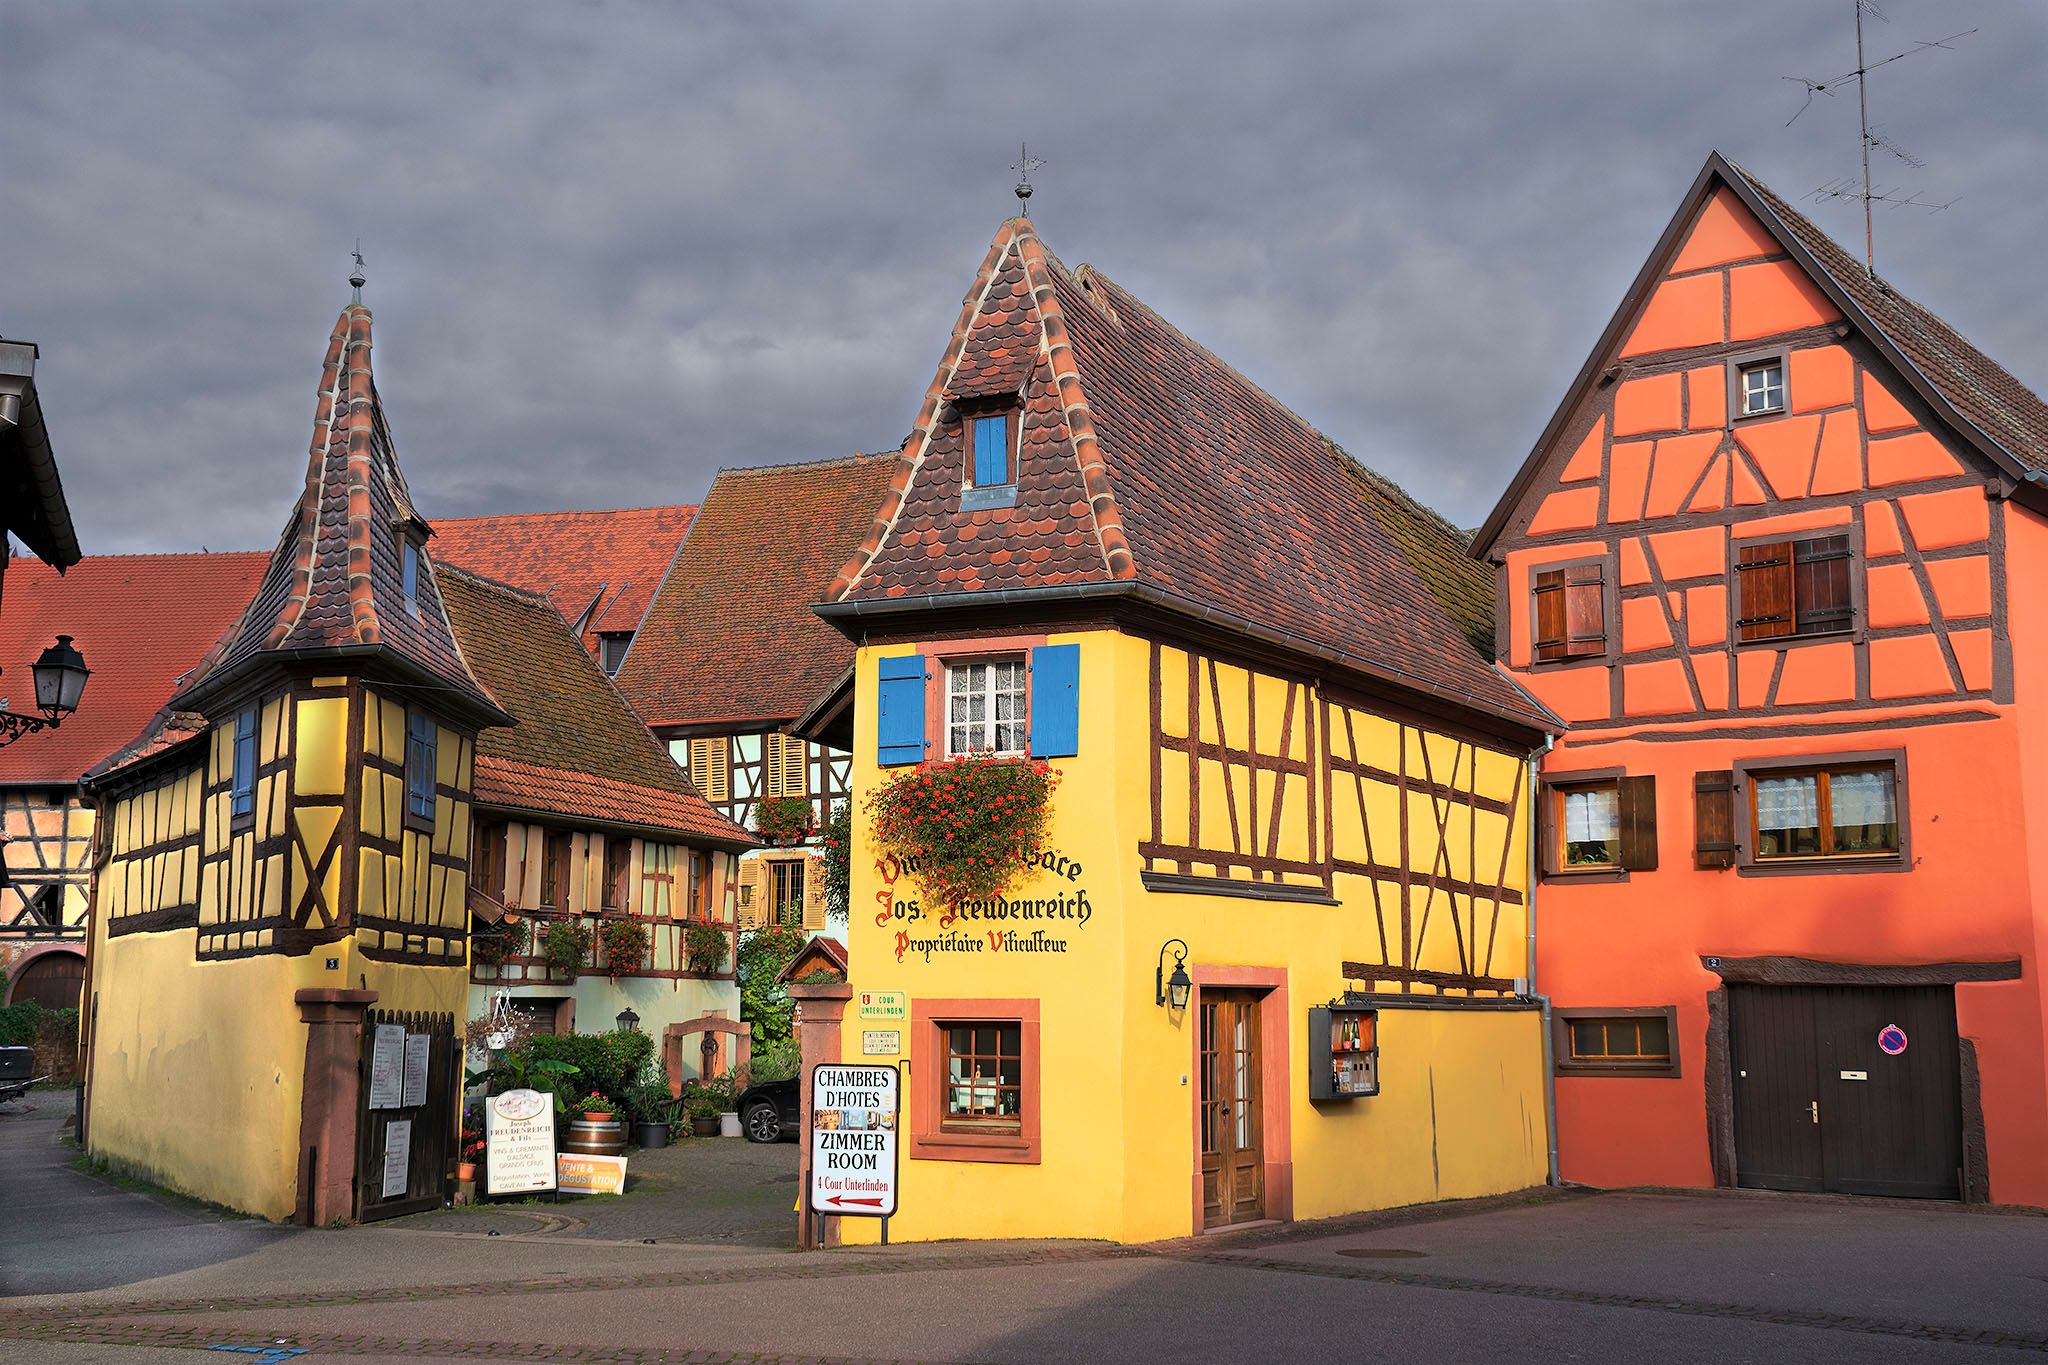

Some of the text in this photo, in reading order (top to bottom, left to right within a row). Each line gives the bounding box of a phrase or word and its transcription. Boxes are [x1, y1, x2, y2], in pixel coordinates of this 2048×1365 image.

[874, 852, 926, 885] Vin
[875, 886, 1092, 931] Jos. Freudenreich
[894, 929, 1067, 964] Propriétaire Viticulteur
[1711, 959, 1718, 967] 2
[879, 996, 895, 1004] COUR
[861, 1007, 903, 1015] UNTERLINDEN
[818, 1070, 889, 1087] CHAMBRES
[826, 1091, 880, 1108] D'HOTES
[490, 1126, 551, 1136] FREUDENREICH
[820, 1133, 885, 1151] ZIMMER
[560, 1162, 594, 1173] VENTE &
[828, 1152, 877, 1170] ROOM
[817, 1176, 889, 1192] 4 Cour Unterlinden
